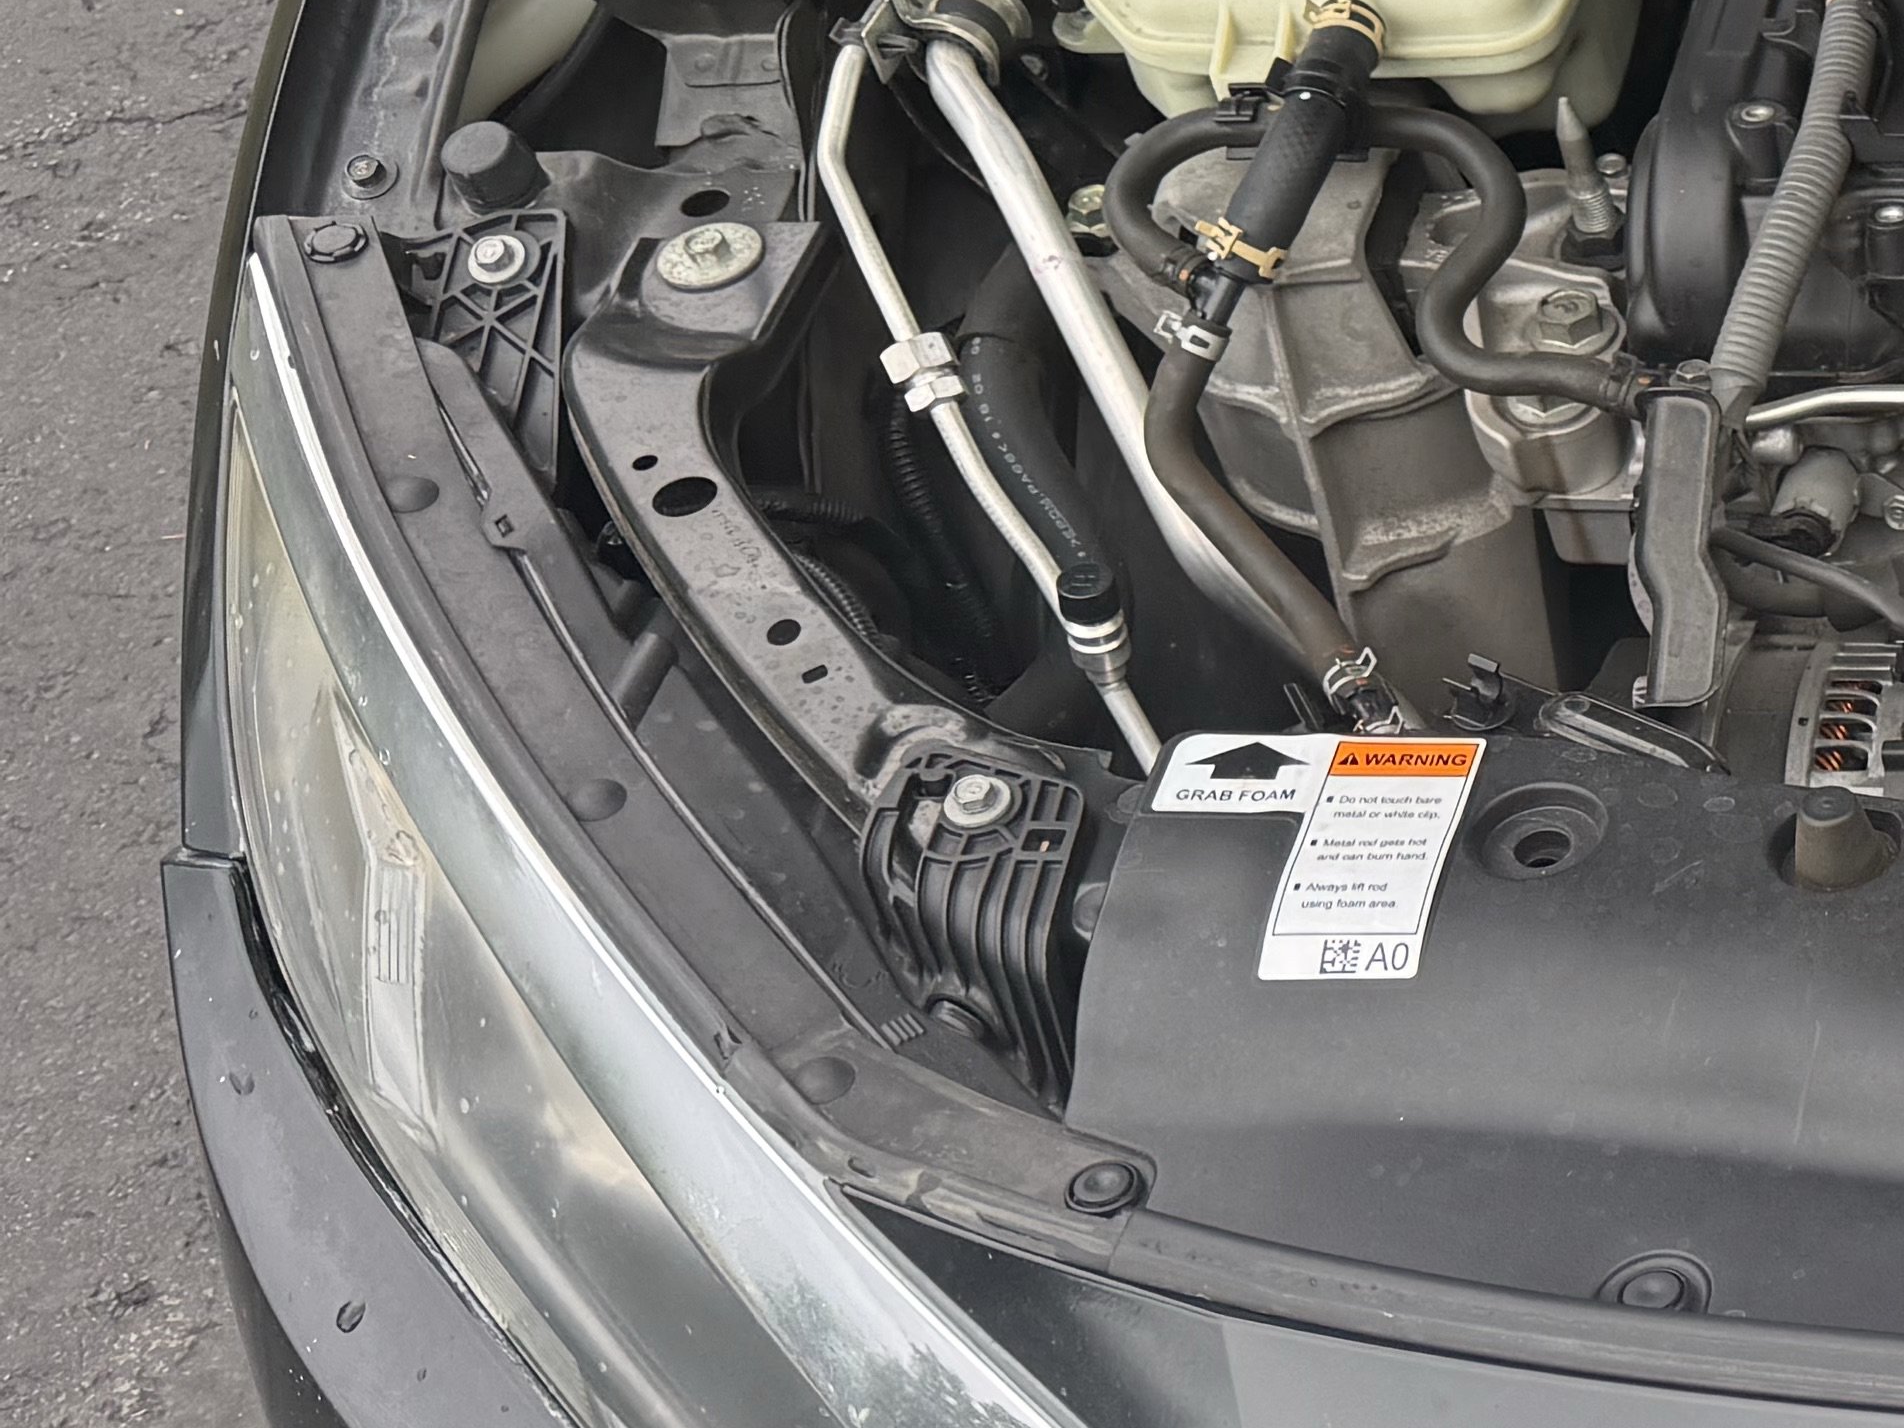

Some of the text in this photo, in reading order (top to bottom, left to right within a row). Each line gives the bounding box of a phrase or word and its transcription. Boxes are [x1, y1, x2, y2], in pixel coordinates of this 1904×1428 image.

[1364, 753, 1468, 767] WARNING
[1175, 788, 1297, 802] GRAB FOAM
[1339, 795, 1443, 805] Do not touch bare
[1333, 810, 1367, 819] metal
[1384, 810, 1415, 819] white
[1417, 810, 1441, 821] clip.
[1322, 838, 1427, 848] Metal rod gets hot
[1316, 852, 1340, 861] and
[1396, 852, 1429, 861] hand.
[1305, 882, 1389, 894] Always lift rod
[1300, 899, 1399, 910] using foam area.
[1364, 942, 1409, 971] A0
